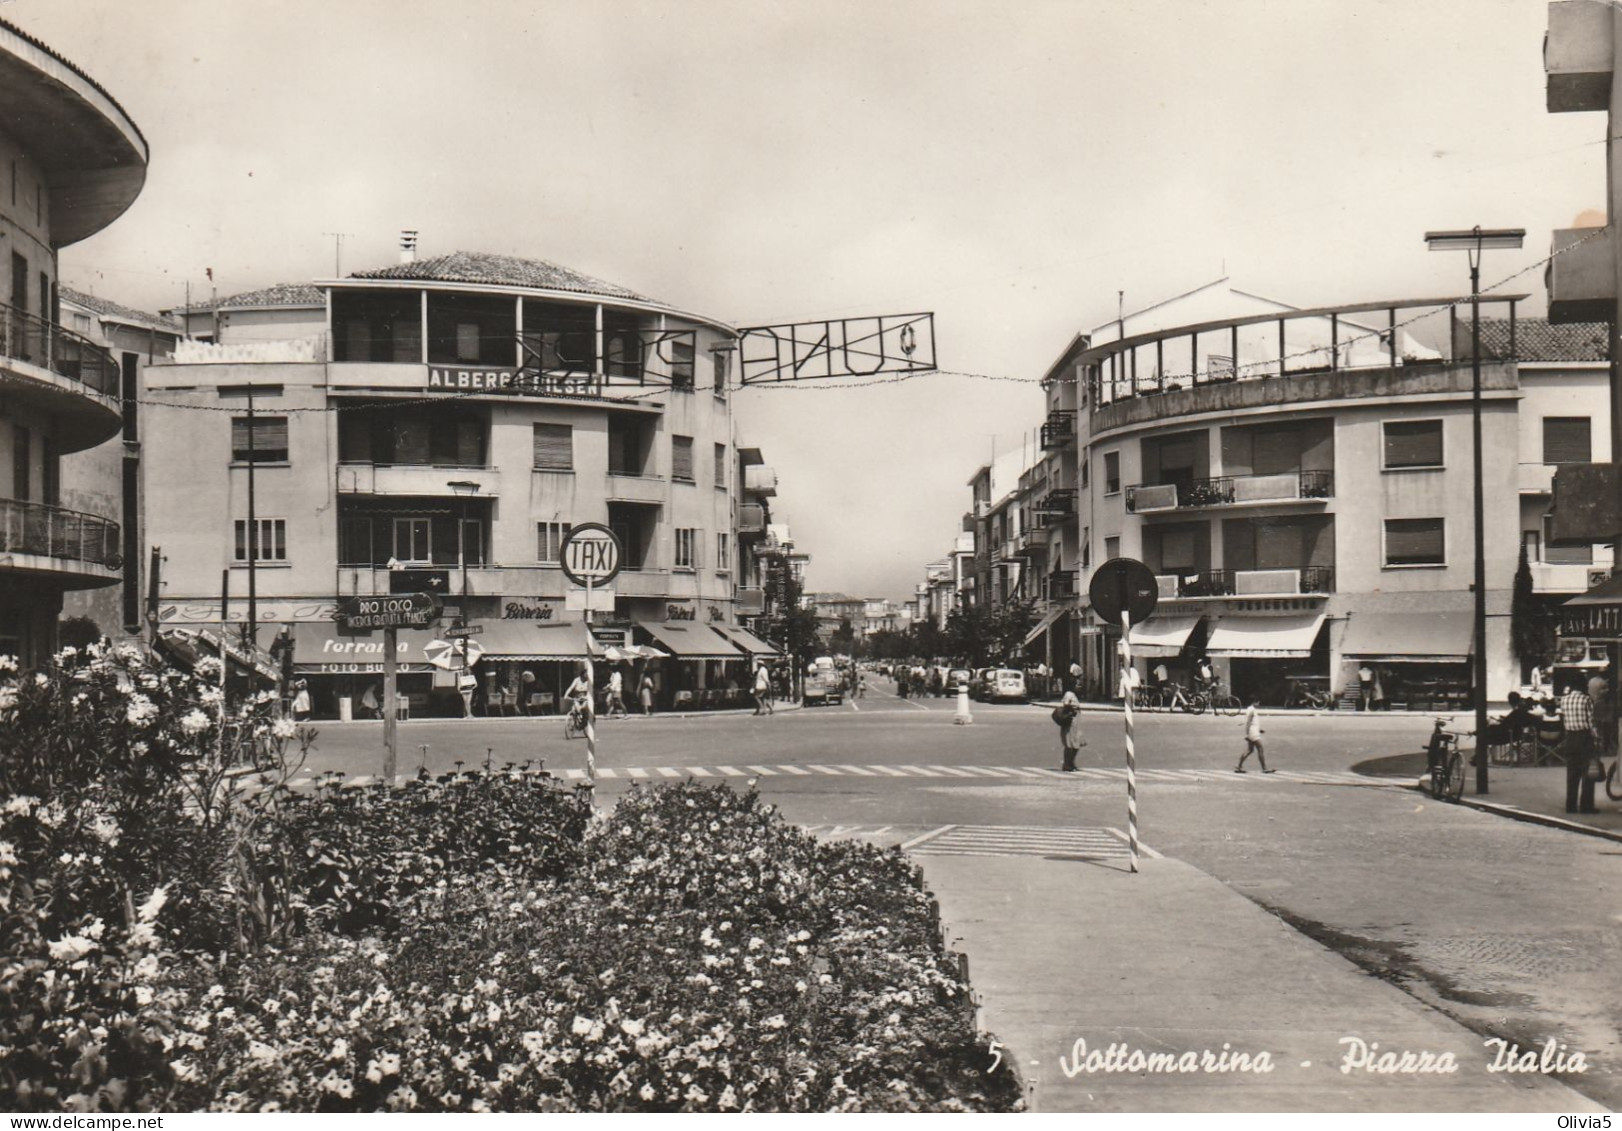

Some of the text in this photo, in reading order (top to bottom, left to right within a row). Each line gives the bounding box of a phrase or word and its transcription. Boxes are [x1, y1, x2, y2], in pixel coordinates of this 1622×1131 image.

[570, 541, 613, 571] TAXI
[360, 601, 379, 614] PRO
[383, 599, 413, 614] LOCO
[501, 602, 552, 620] Birreria
[1589, 608, 1622, 630] LATT
[321, 663, 410, 673] FOTO BUO
